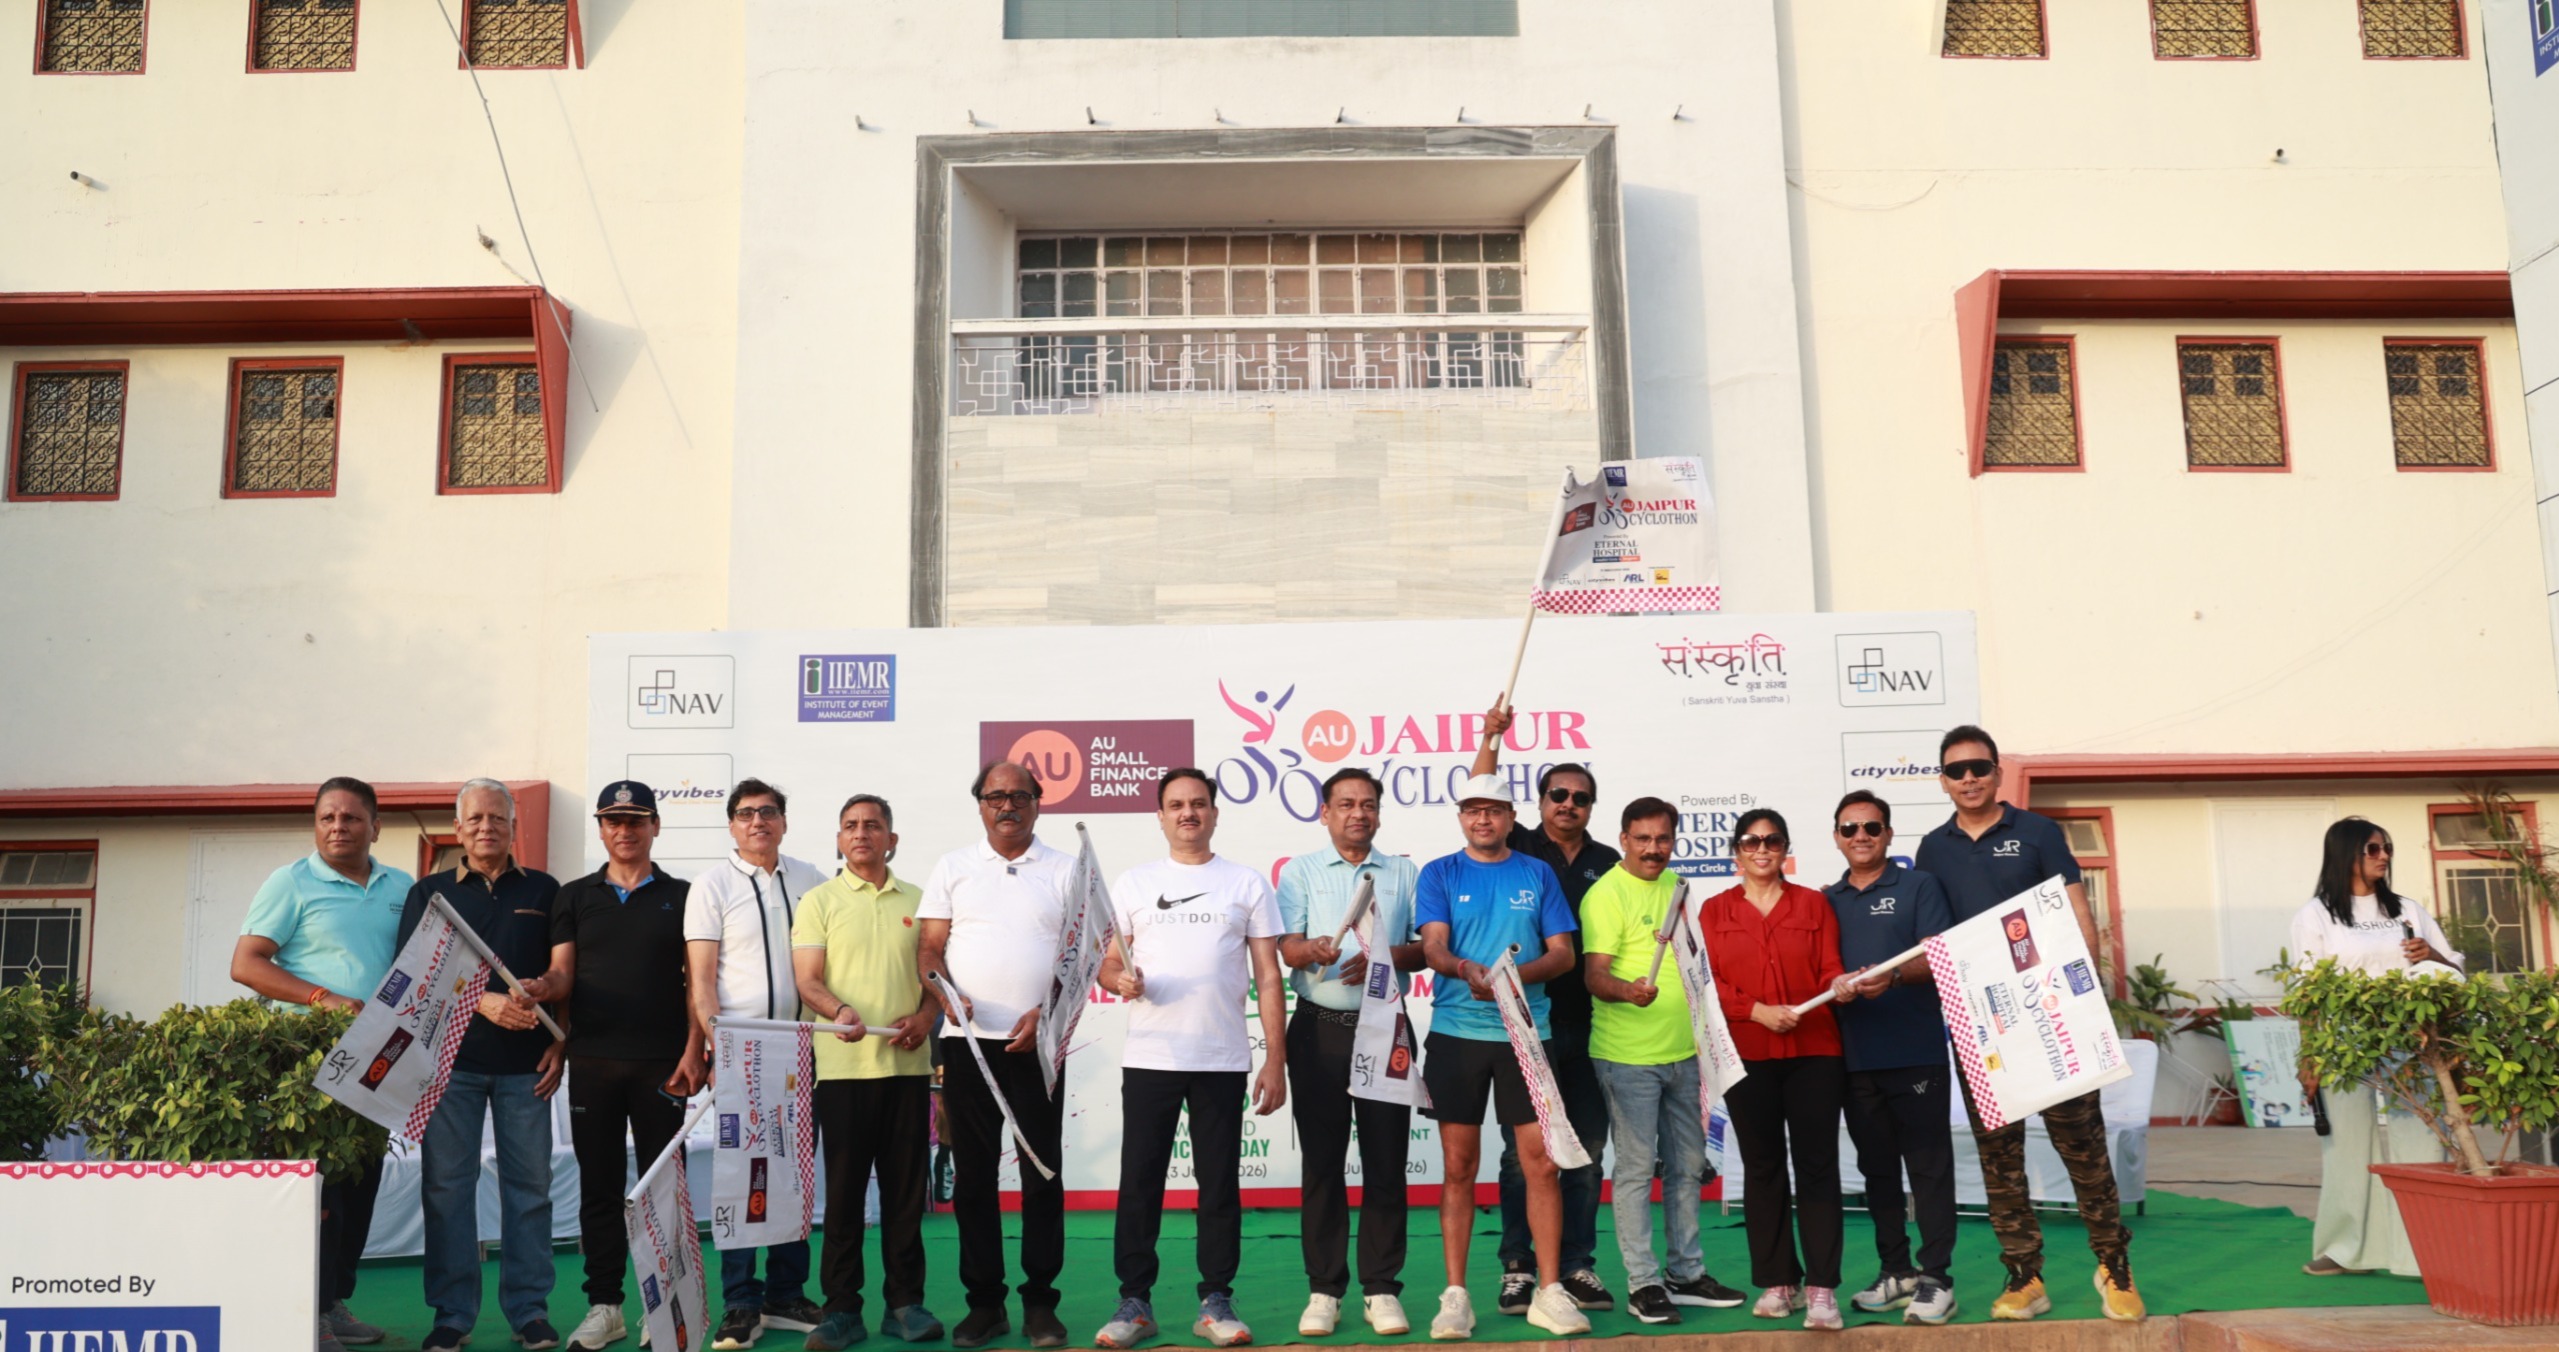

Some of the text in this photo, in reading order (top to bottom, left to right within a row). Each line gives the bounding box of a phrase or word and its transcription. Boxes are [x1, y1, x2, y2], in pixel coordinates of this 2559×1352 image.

[1636, 499, 1697, 511] JAIPUR
[1629, 512, 1698, 525] CYCLOTHON
[1594, 540, 1639, 549] ETERNAL
[1593, 548, 1640, 556] HOSPITAL
[827, 661, 890, 689] IIEMR
[1879, 670, 1933, 692] NAV
[669, 693, 724, 715] NAV
[804, 700, 889, 709] INSTITUTE OF EVENT
[1726, 696, 1748, 704] Yuva
[1749, 694, 1785, 704] Sanstha
[818, 710, 875, 719] MANAGEMENT
[1308, 711, 1592, 755] AU JAIPUR
[1090, 736, 1116, 750] AU
[1090, 752, 1149, 765] SMALL
[1021, 751, 1072, 782] AU
[1851, 763, 1943, 779] cityvibes
[1090, 767, 1168, 781] FINANCE
[652, 787, 725, 801] tyvibes
[1090, 783, 1141, 797] BANK
[1681, 793, 1758, 807] Powered By
[1677, 811, 1744, 833] TERN
[1700, 863, 1727, 873] Circle
[1730, 863, 1738, 872] &
[2353, 919, 2403, 931] ASHION
[2031, 1007, 2069, 1082] CYCLOTHON
[2050, 1012, 2080, 1076] JAIPUR
[753, 1039, 764, 1117] CYCLOTHON
[12, 1275, 156, 1296] Promoted By
